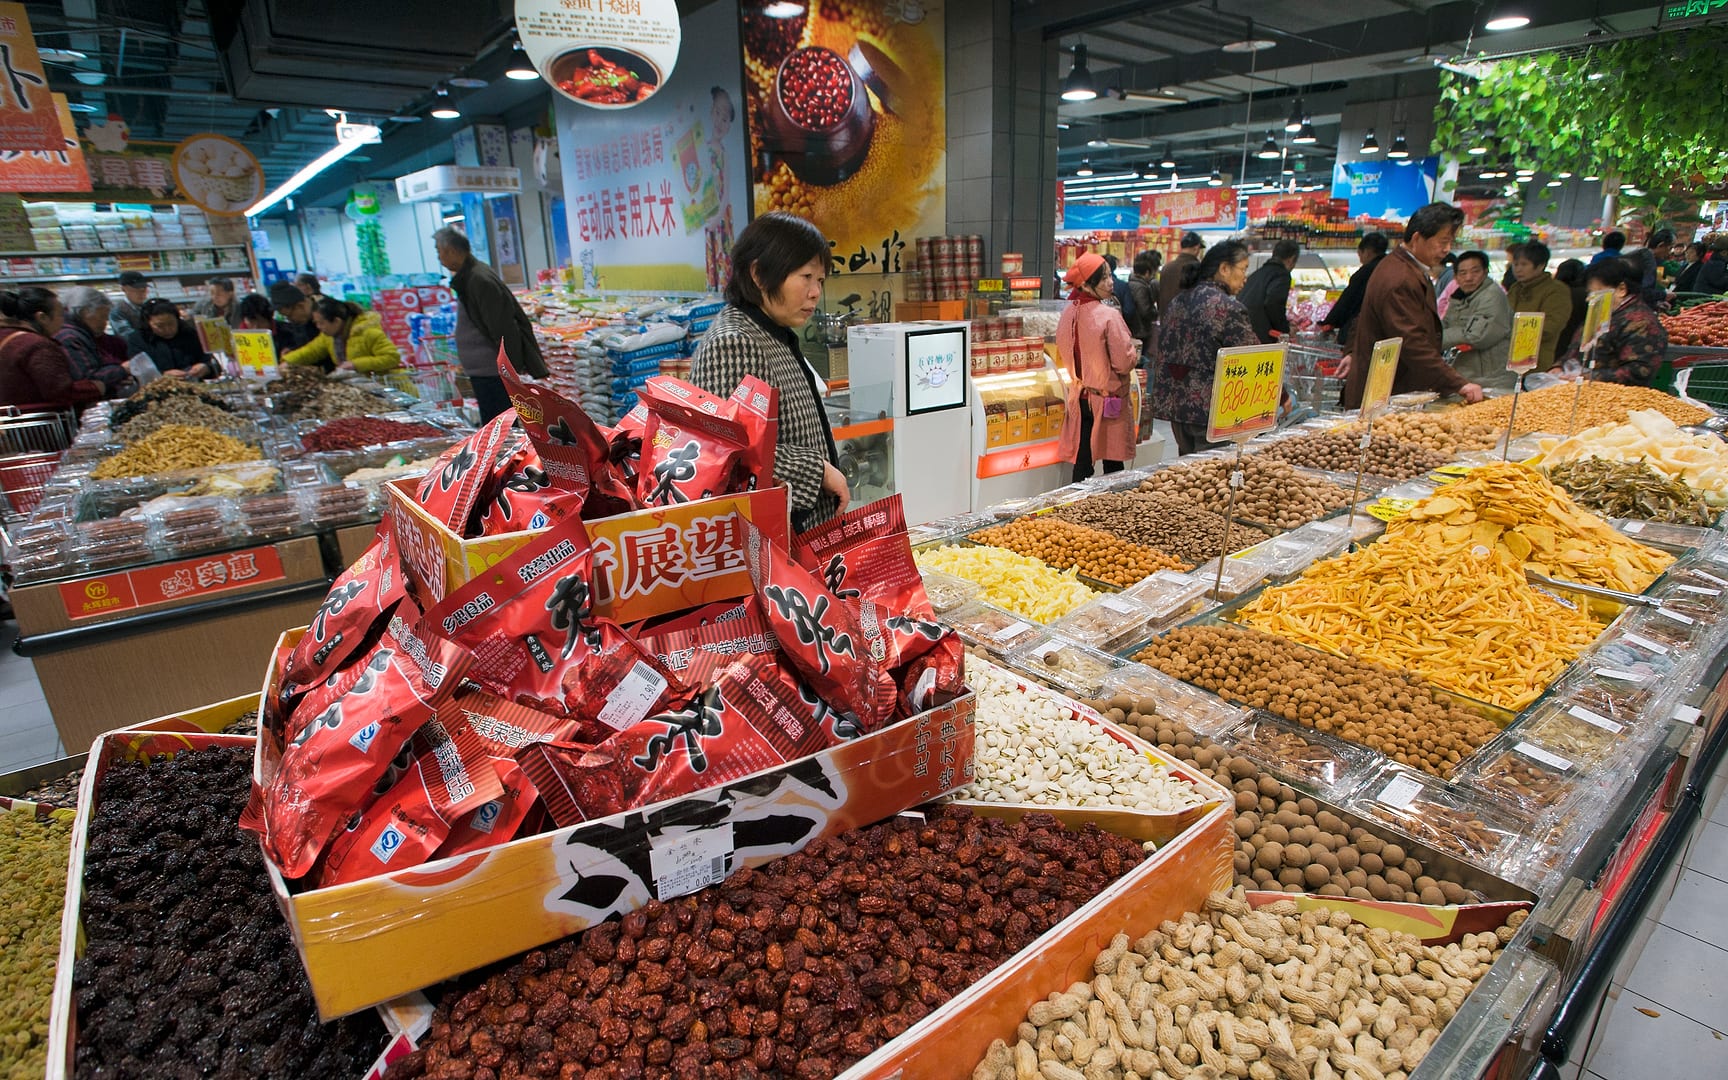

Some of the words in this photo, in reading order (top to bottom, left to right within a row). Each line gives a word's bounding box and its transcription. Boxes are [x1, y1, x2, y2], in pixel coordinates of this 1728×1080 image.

[576, 178, 676, 243] 运动员专用大米
[196, 552, 260, 589] 实惠
[517, 538, 577, 584] 荣誉出品
[82, 596, 120, 612] 永辉超市
[640, 683, 657, 701] 2.90
[695, 874, 711, 887] 0.00
